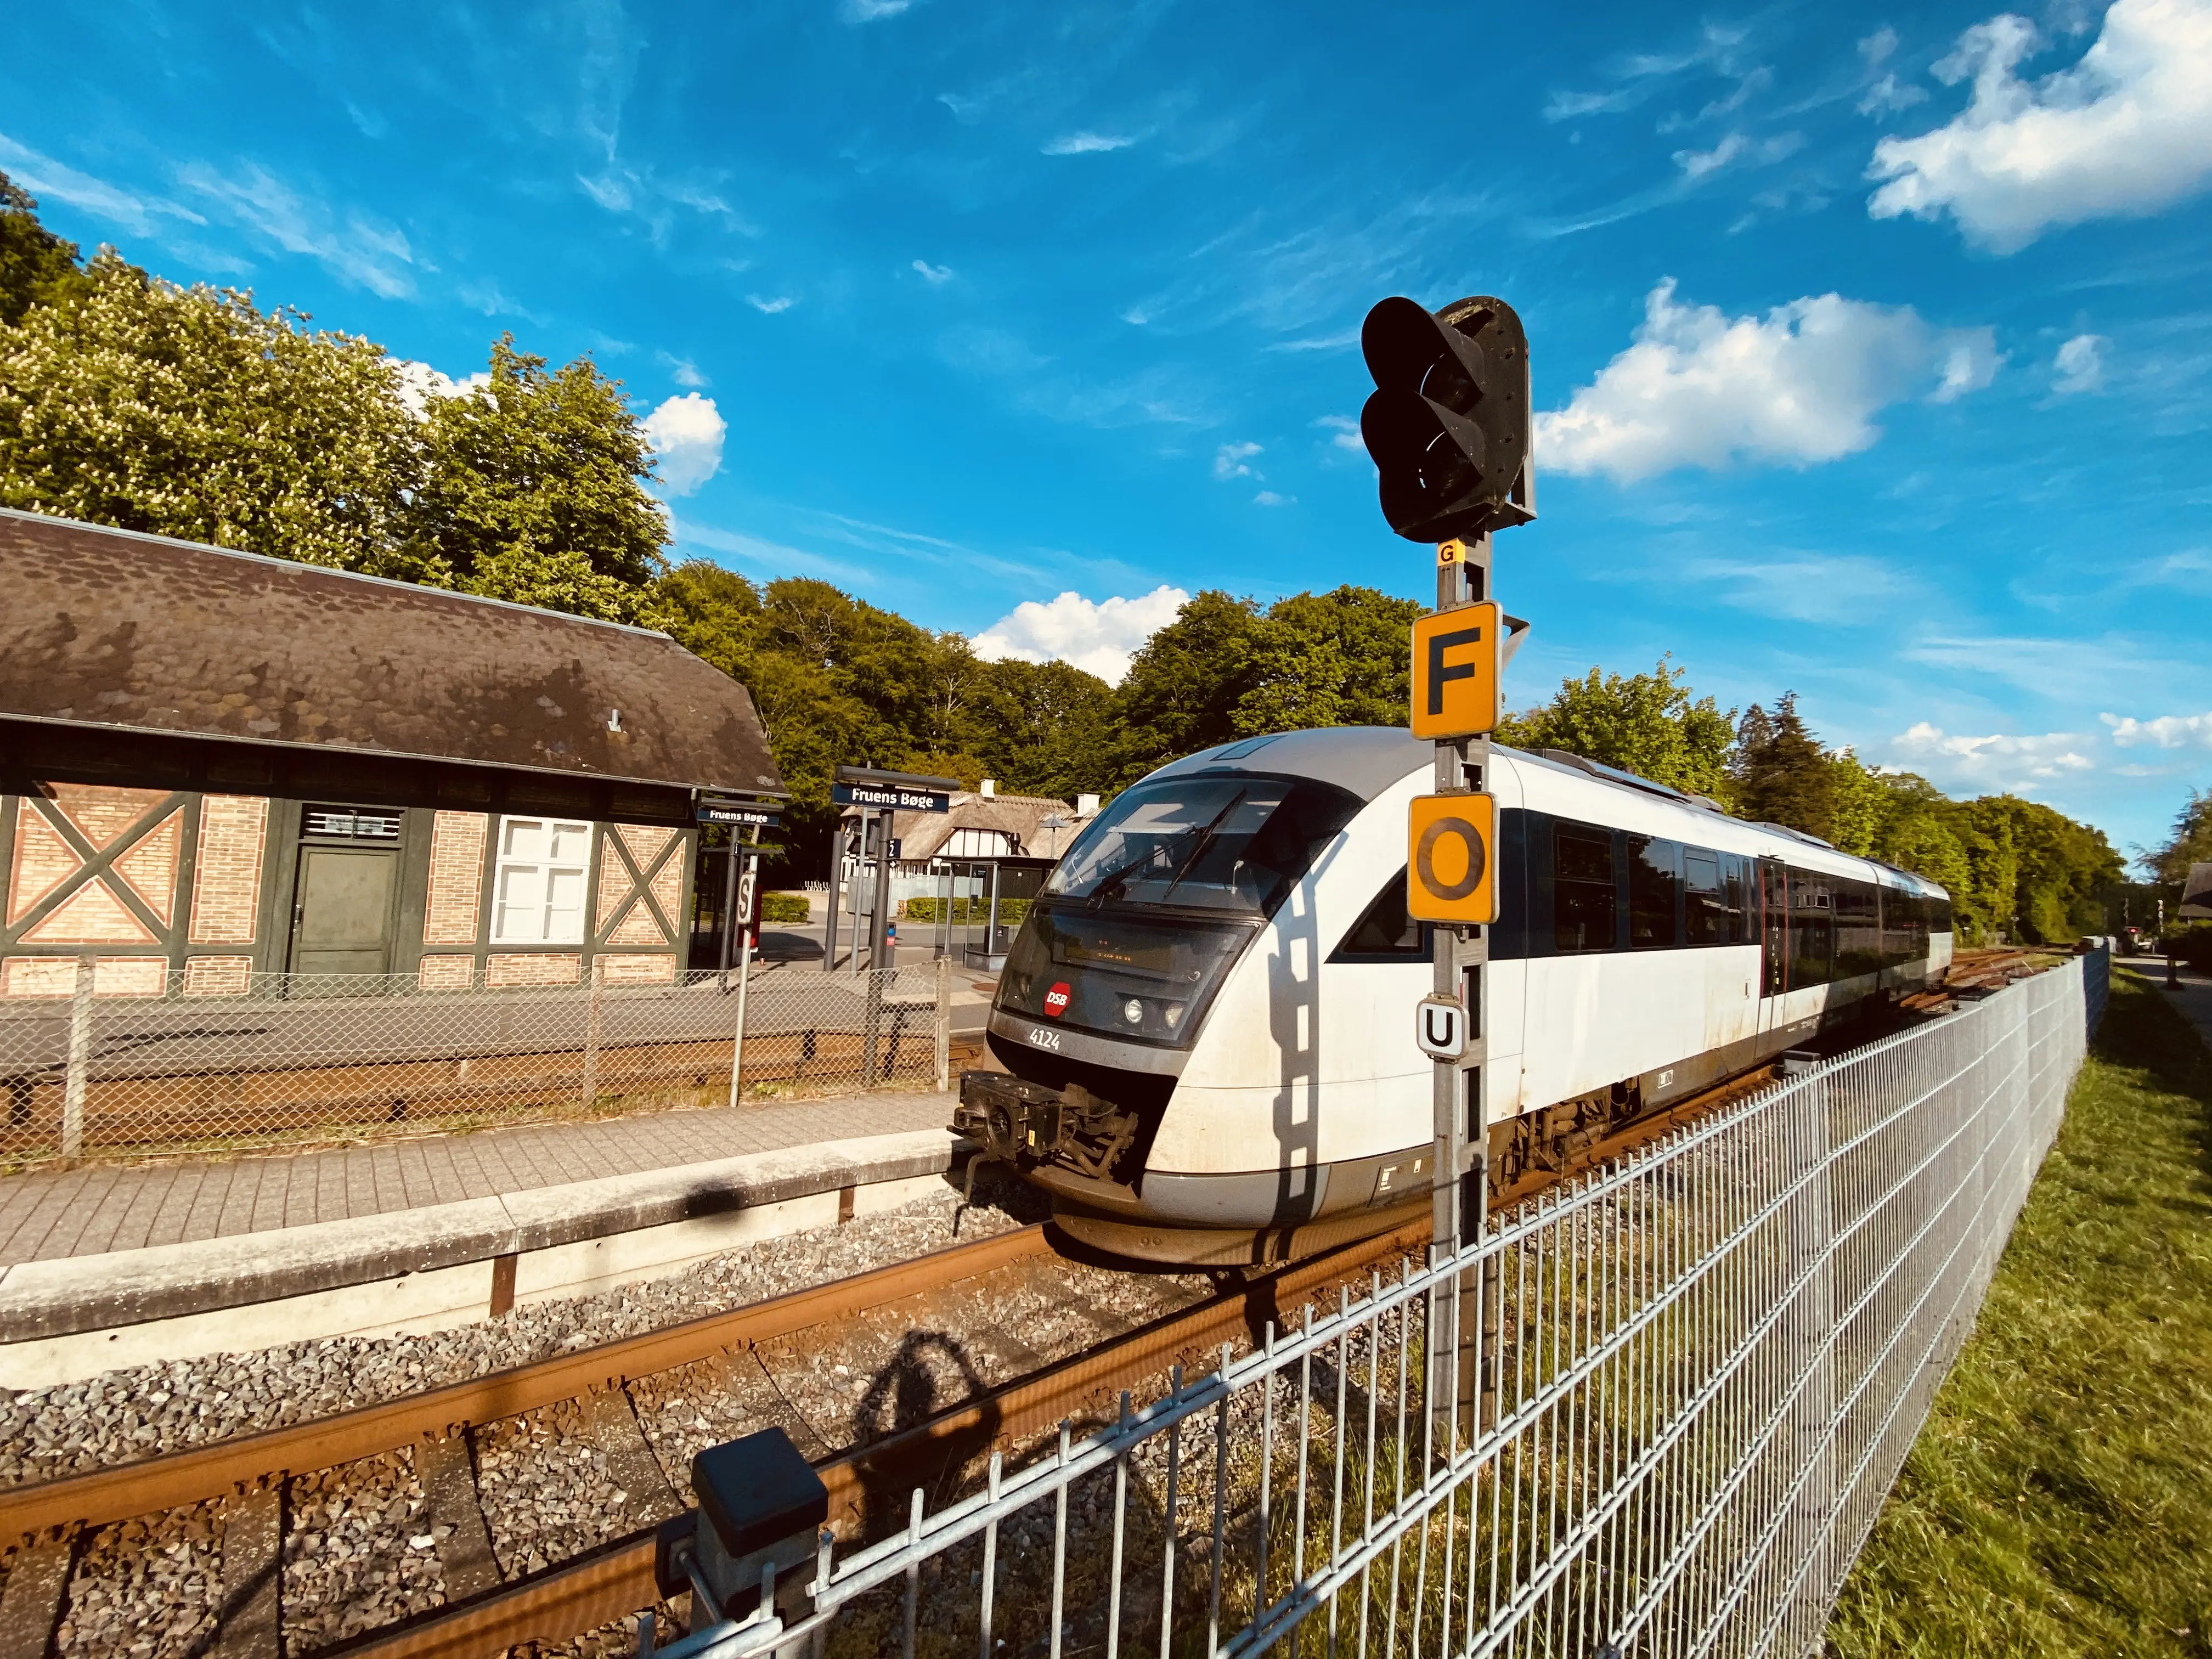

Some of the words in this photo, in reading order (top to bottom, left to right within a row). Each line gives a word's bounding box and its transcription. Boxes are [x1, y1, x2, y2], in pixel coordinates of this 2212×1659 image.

[1441, 545, 1454, 562] G
[1428, 627, 1481, 715] F
[852, 788, 897, 804] Fruens
[901, 793, 934, 809] Bøge
[710, 810, 741, 821] Fruens
[744, 812, 768, 823] Bøge
[889, 844, 894, 857] 2
[1417, 816, 1486, 901] O
[739, 878, 750, 919] S
[1047, 991, 1068, 1006] DSB
[1426, 1008, 1453, 1047] U
[1029, 1028, 1060, 1050] 4124
